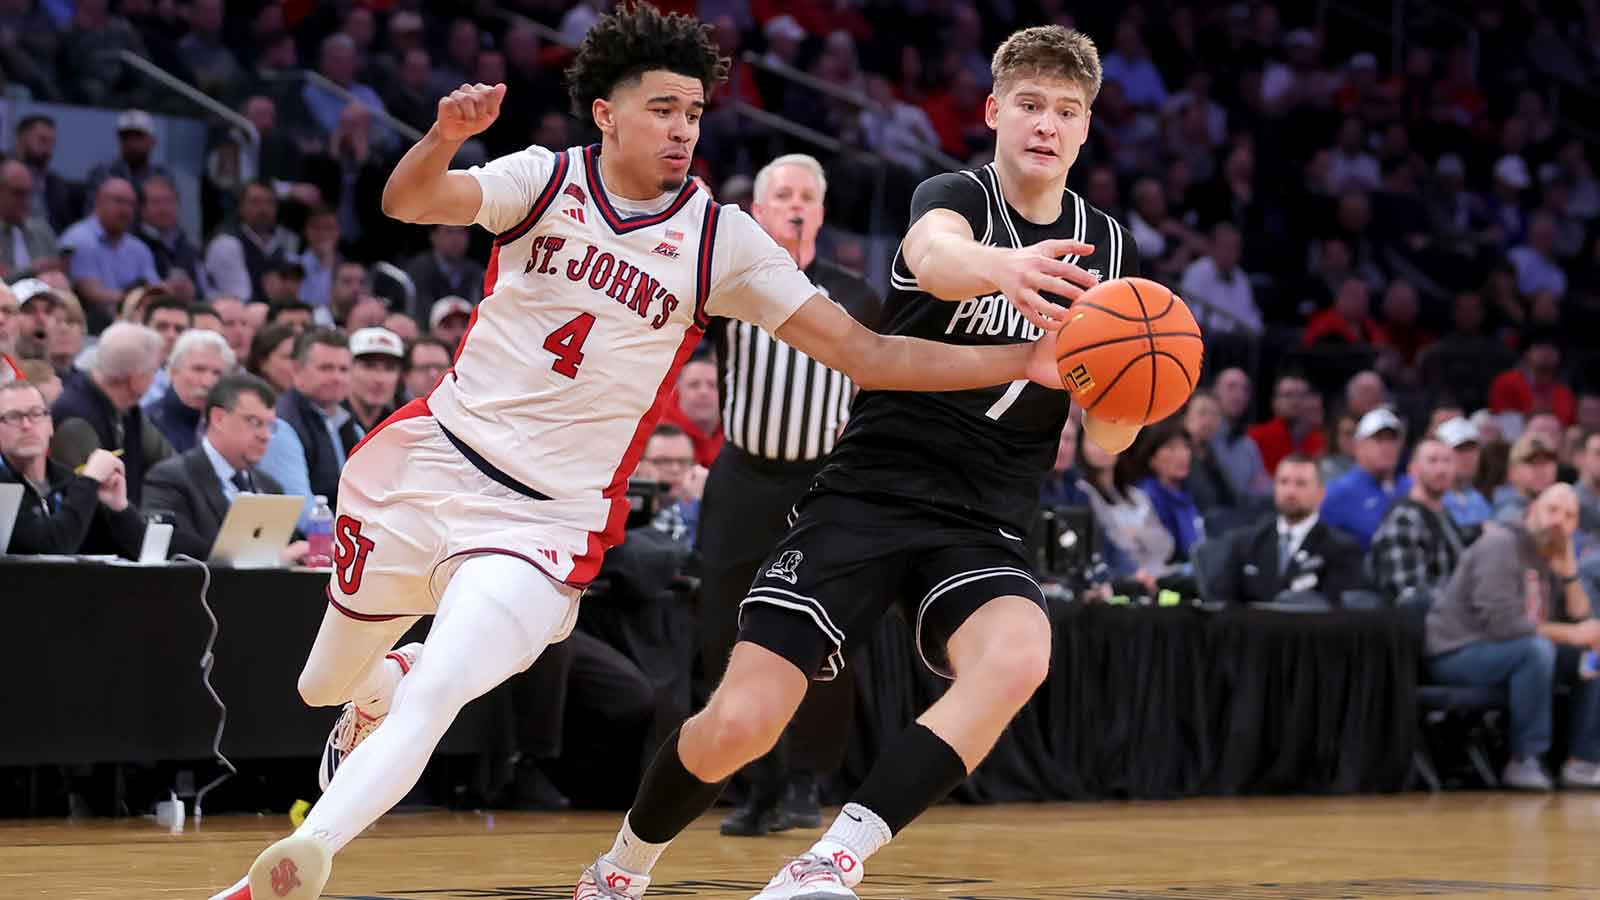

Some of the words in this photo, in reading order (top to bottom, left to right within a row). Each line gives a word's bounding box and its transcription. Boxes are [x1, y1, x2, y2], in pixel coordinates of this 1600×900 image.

[524, 235, 567, 275] ST.
[566, 245, 680, 331] JOHN'S
[542, 311, 597, 380] 4
